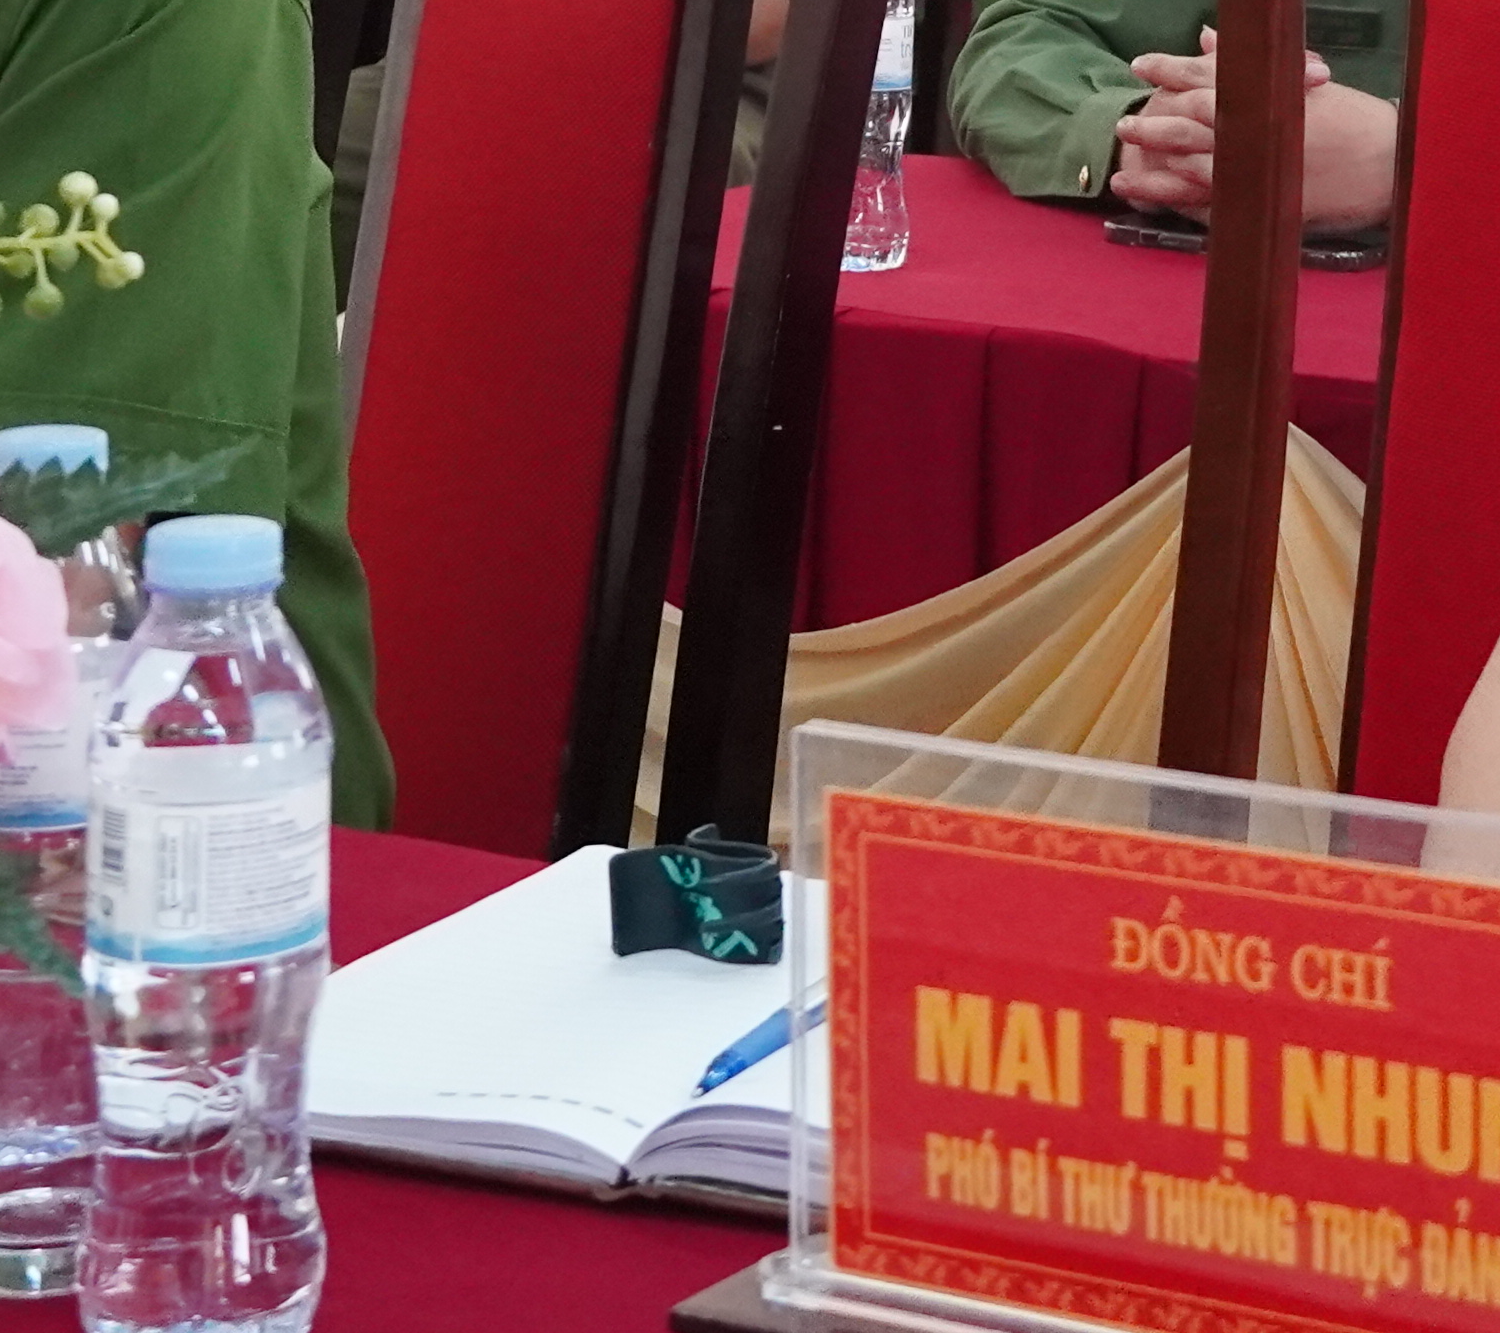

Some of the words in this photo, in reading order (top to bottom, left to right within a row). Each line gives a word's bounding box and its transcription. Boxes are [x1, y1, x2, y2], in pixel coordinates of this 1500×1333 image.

[1290, 937, 1396, 1013] CHÍ
[915, 984, 1083, 1109] MAI
[1108, 1017, 1250, 1161] THỊ
[925, 1127, 999, 1212] PHÓ
[1009, 1136, 1050, 1221] BÍ
[1057, 1159, 1137, 1239] THƯ
[1140, 1165, 1298, 1267] THƯỜNG
[1305, 1200, 1412, 1306] TRỰC
